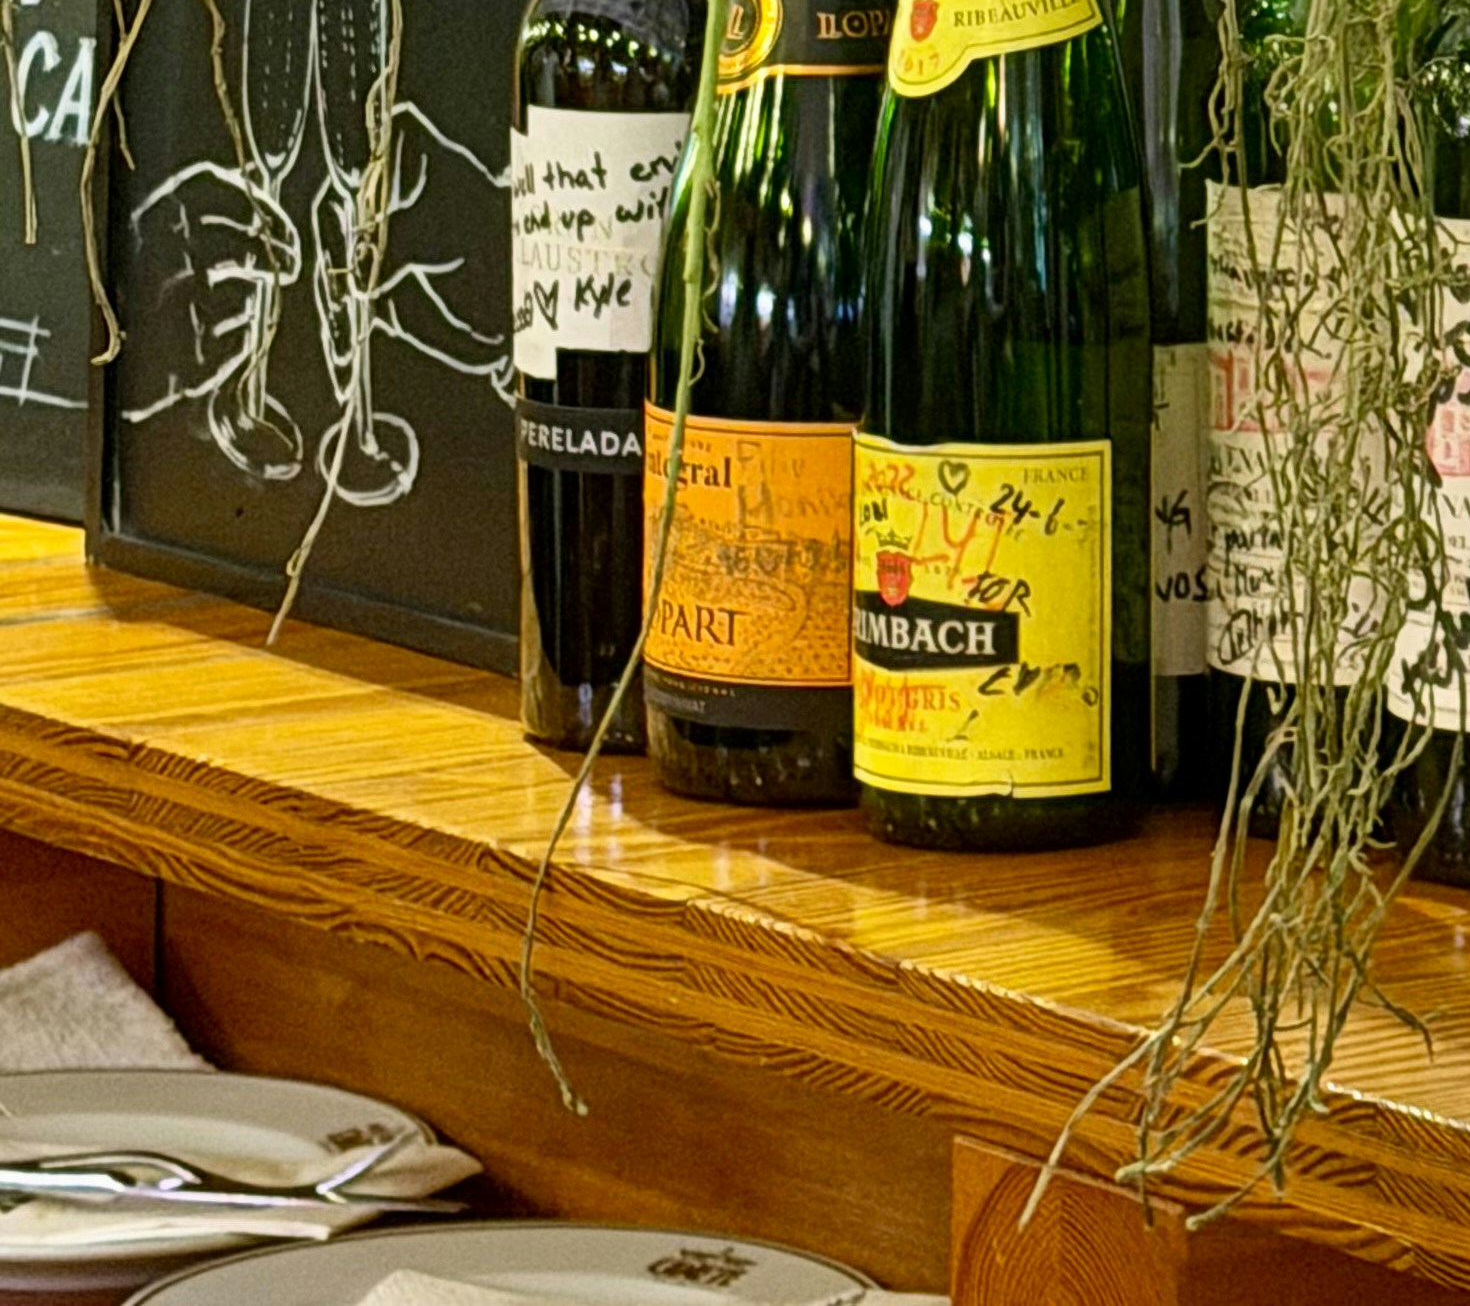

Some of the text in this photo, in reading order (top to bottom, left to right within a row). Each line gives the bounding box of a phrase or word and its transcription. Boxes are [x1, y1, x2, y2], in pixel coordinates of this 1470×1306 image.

[543, 151, 608, 191] that
[561, 208, 595, 243] up
[574, 272, 632, 320] Kyle
[519, 419, 642, 459] PERELADA
[1022, 467, 1090, 485] FRANCE
